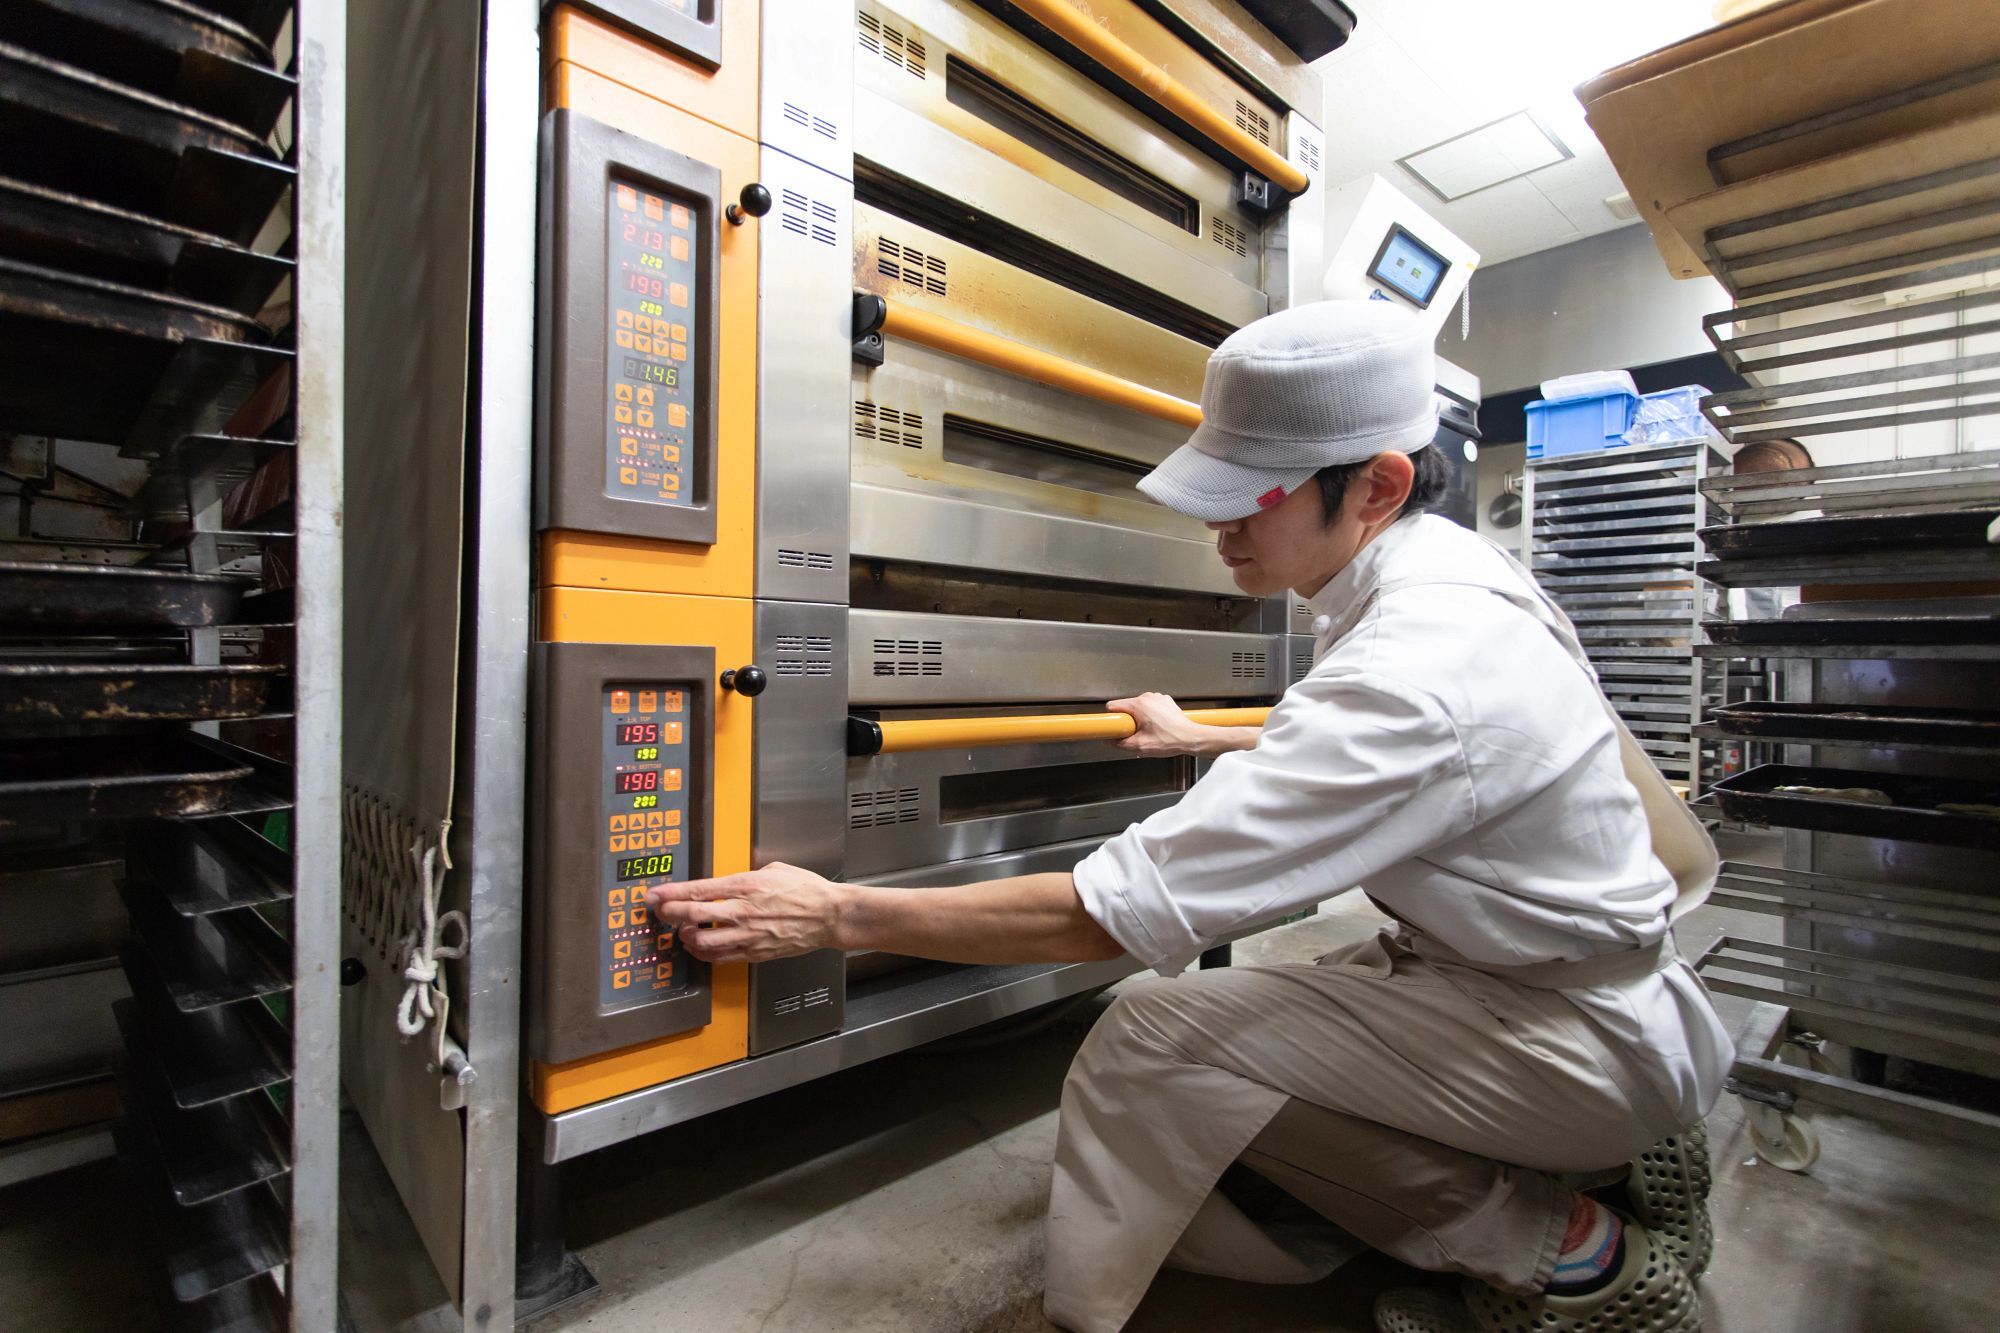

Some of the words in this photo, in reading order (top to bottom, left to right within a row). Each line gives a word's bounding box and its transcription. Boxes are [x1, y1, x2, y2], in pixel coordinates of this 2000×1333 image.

[639, 300, 663, 316] 200
[625, 725, 656, 742] 195
[637, 748, 657, 760] 190
[624, 772, 656, 791] 198
[633, 795, 657, 808] 200
[625, 855, 673, 877] 15.00
